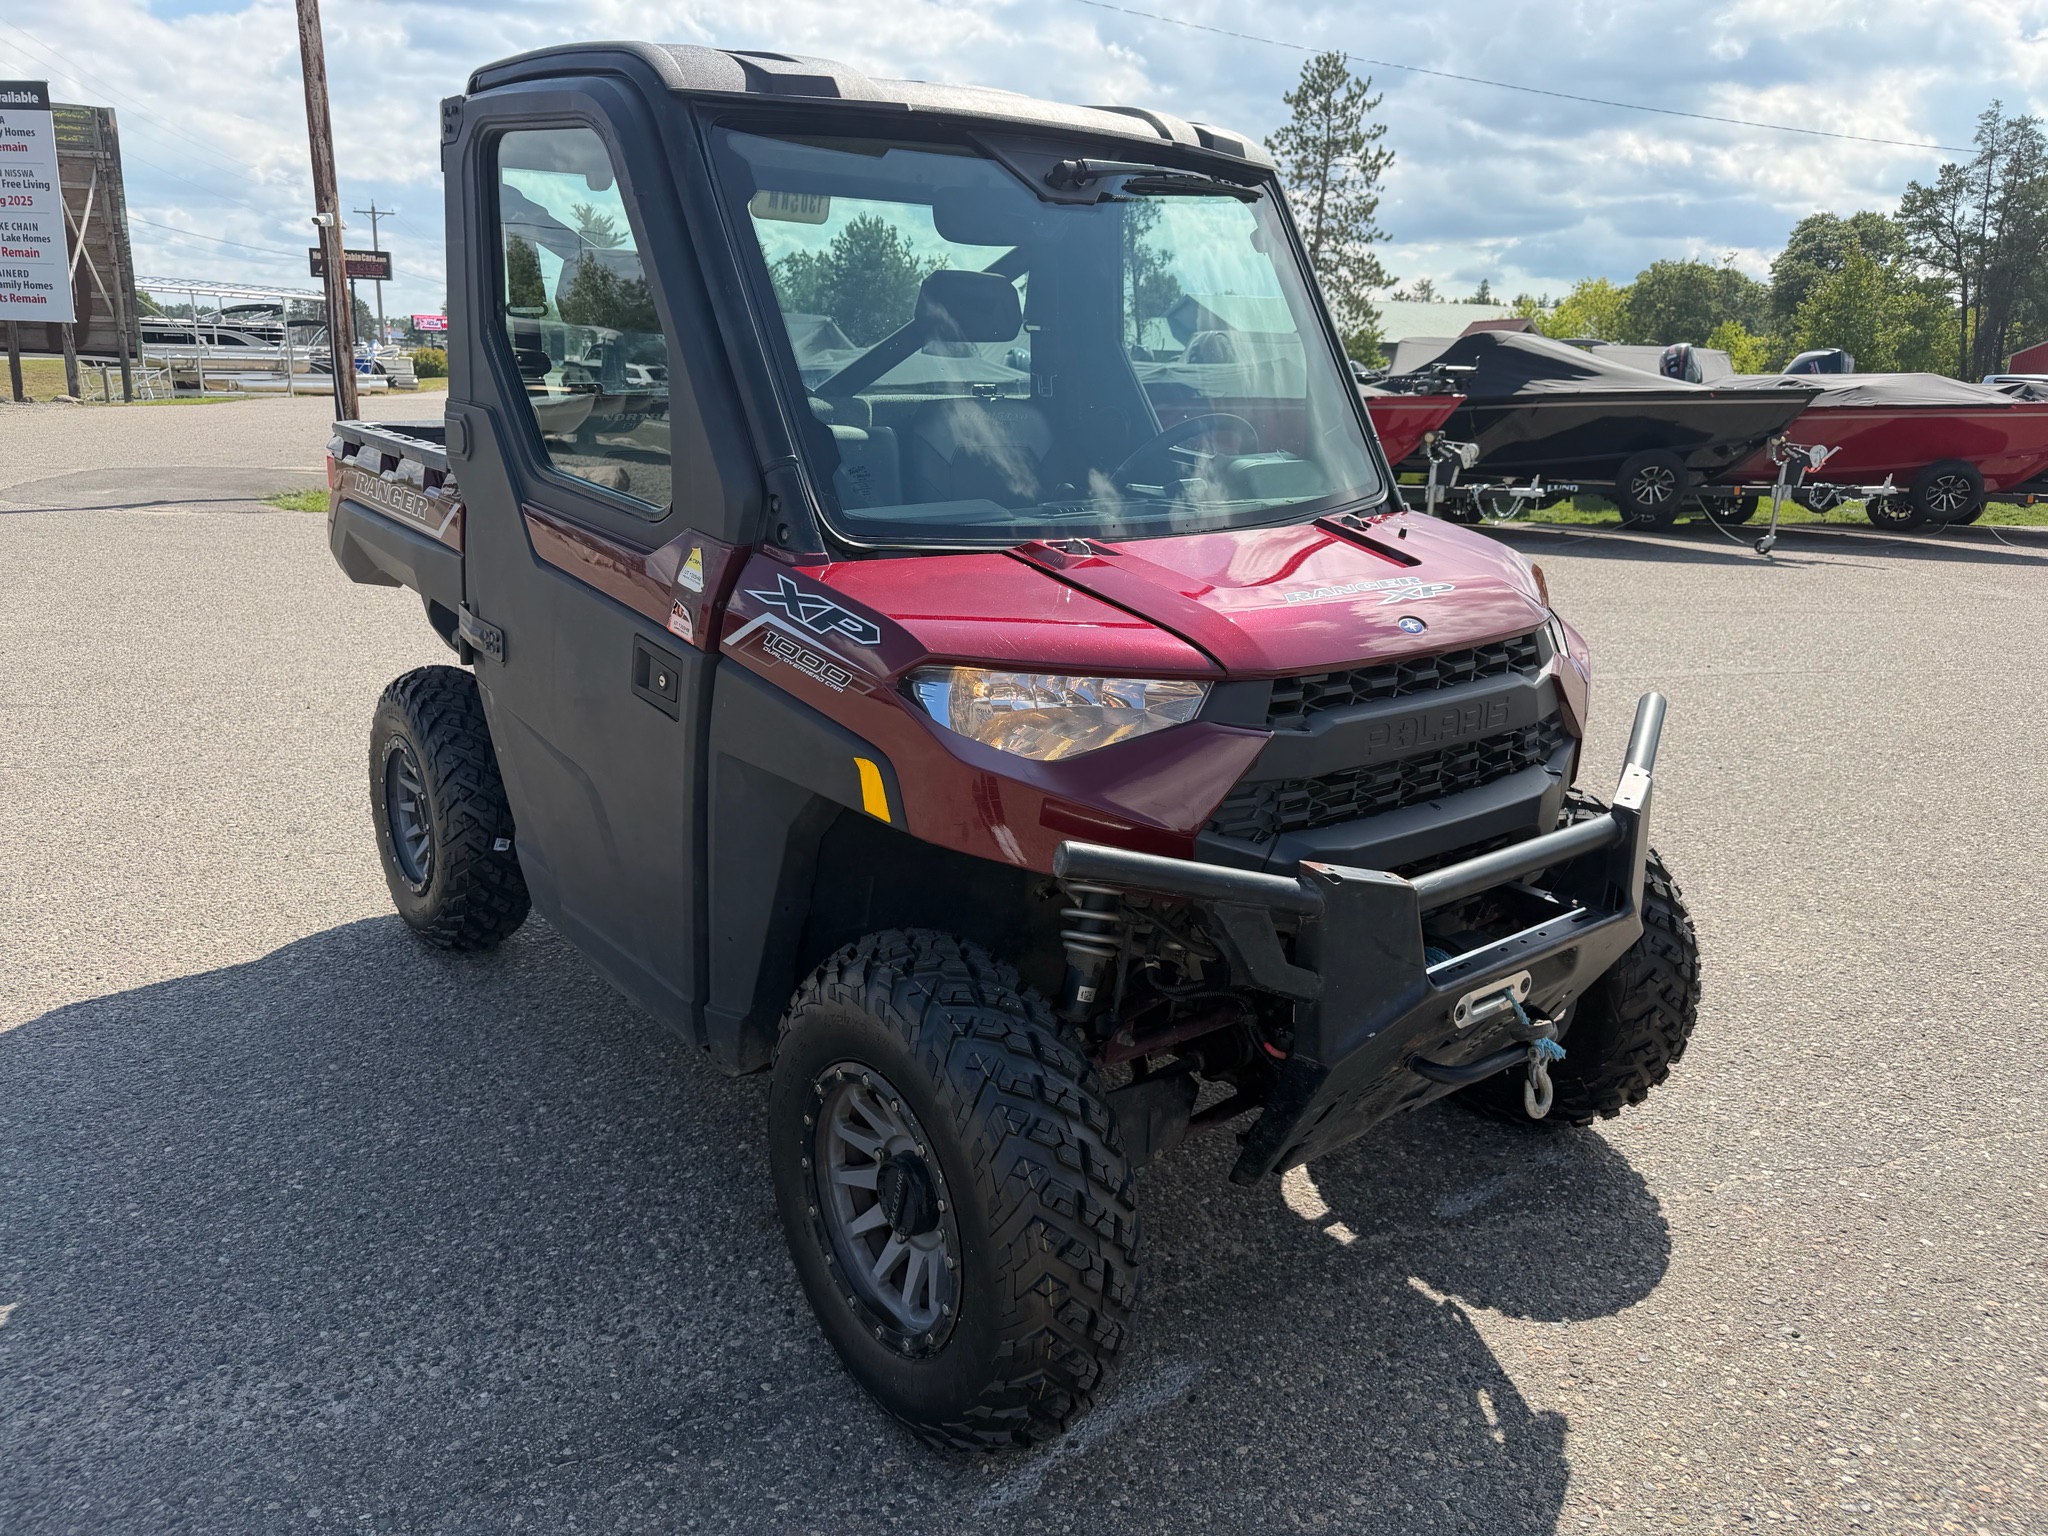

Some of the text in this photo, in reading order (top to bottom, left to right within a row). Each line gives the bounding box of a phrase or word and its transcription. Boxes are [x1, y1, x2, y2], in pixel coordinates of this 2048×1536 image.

[5, 127, 36, 137] Homes
[0, 141, 28, 152] main
[4, 169, 34, 178] NISSWA
[2, 179, 50, 191] Free Living
[7, 195, 33, 206] 2025
[11, 222, 39, 232] CHAIN
[1, 233, 51, 243] Lake Homes
[1, 246, 40, 258] Remain
[23, 281, 53, 290] Homes
[9, 293, 47, 304] Remain
[1546, 484, 1579, 493] LUND
[355, 472, 429, 520] RANGER
[1284, 576, 1424, 604] RANGER
[1377, 583, 1456, 606] XP
[744, 573, 881, 645] XP
[763, 631, 853, 688] 1000
[762, 646, 844, 694] DUAL OVERHEAD CAM
[1363, 696, 1510, 757] POLARIS
[889, 1169, 904, 1229] RACELINE
